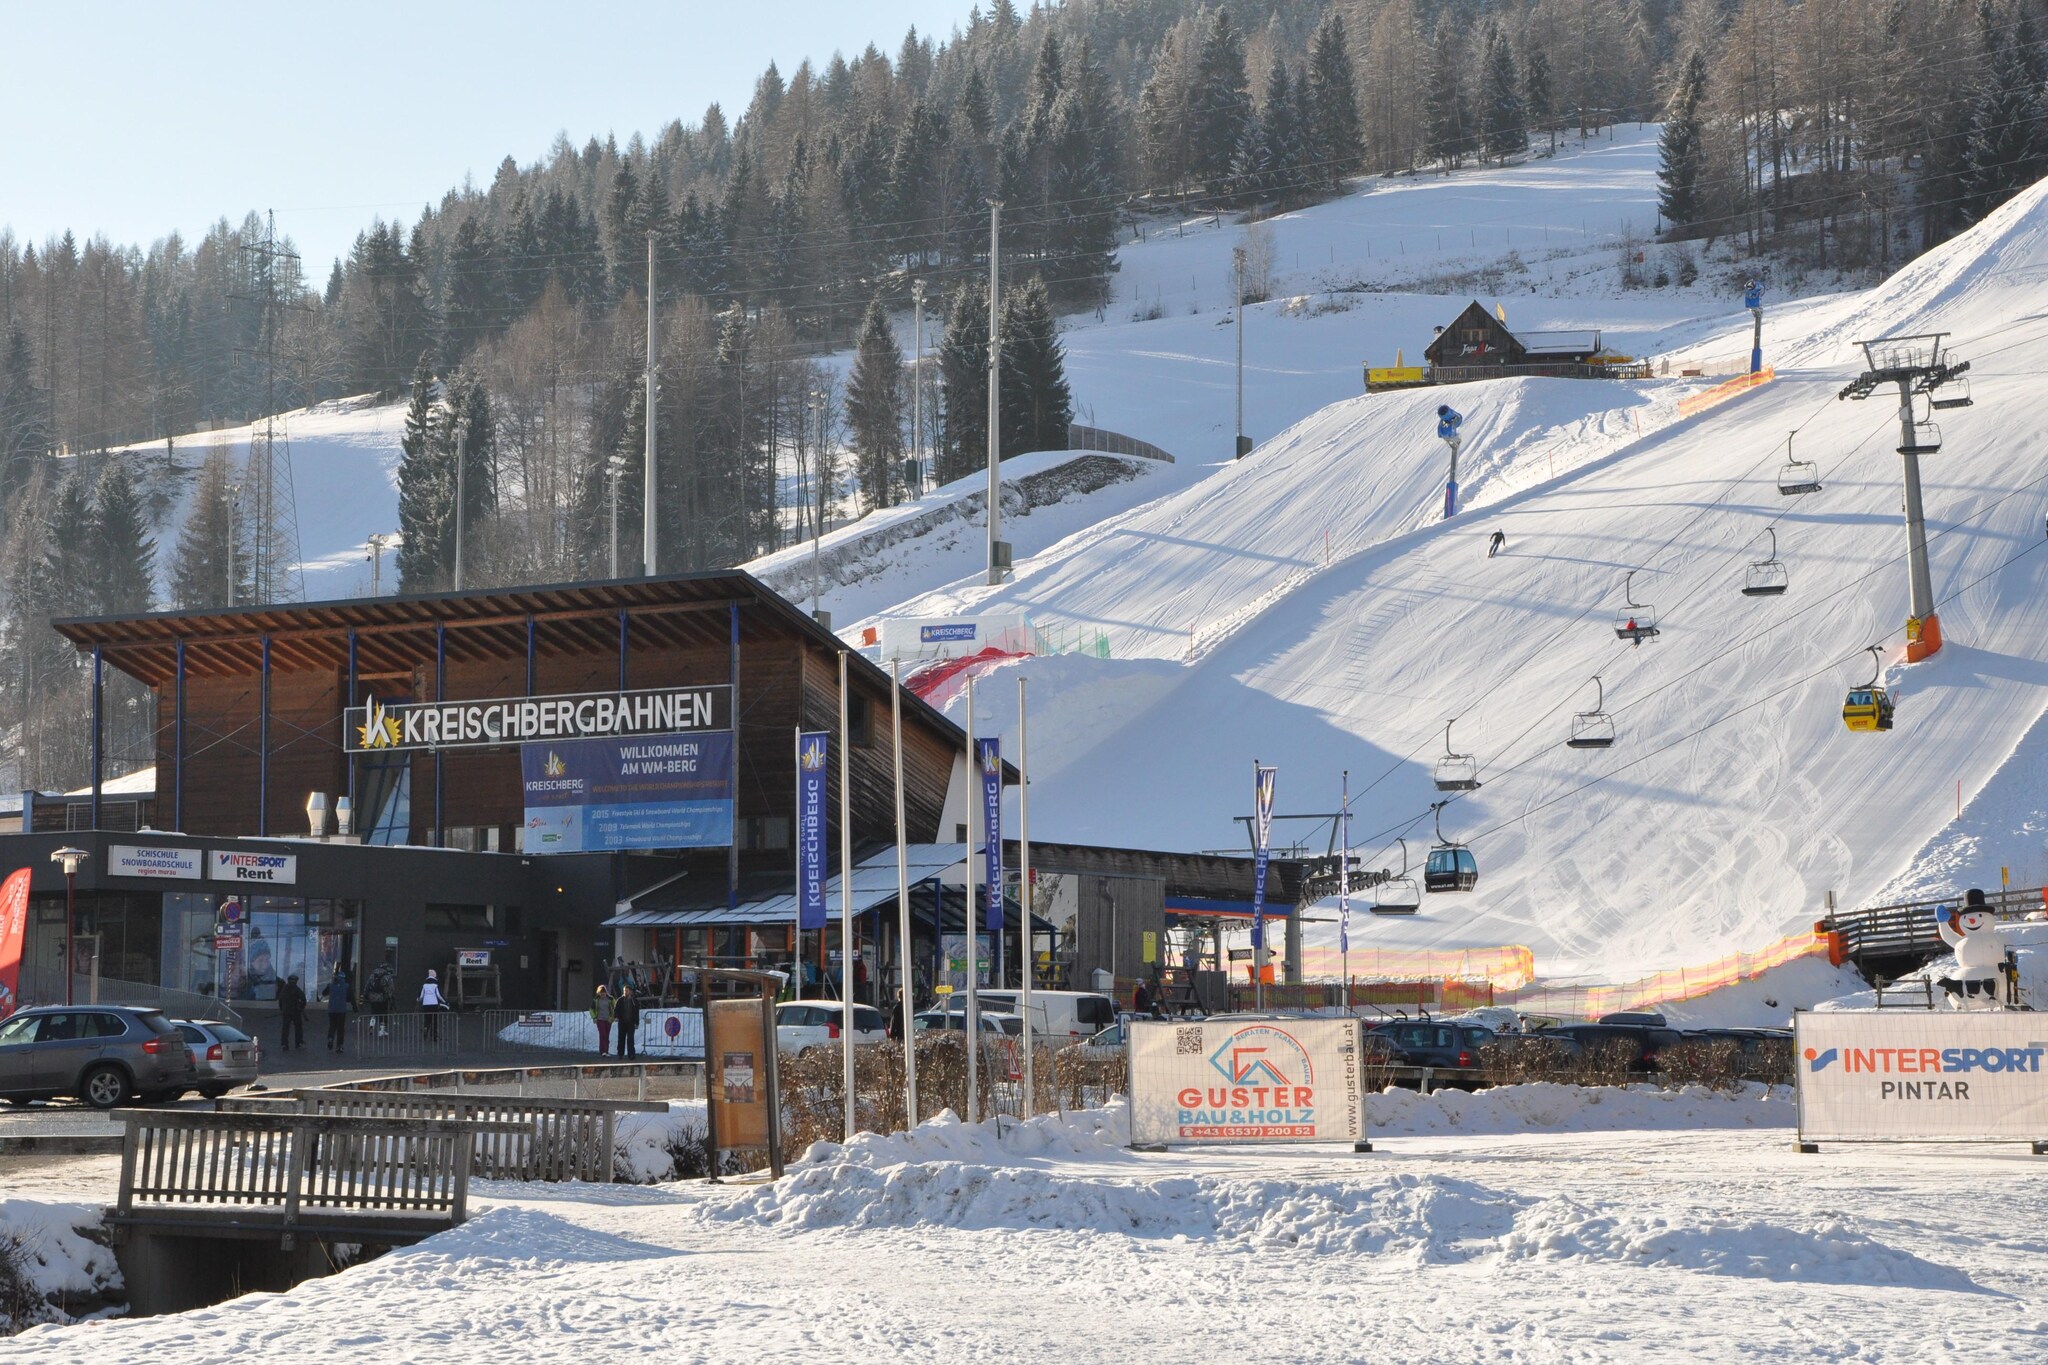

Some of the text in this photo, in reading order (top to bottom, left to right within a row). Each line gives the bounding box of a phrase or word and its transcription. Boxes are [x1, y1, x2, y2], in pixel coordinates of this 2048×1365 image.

[932, 628, 973, 636] KREISCHBERG
[404, 691, 713, 743] KREISCHBERGBAHNEN
[620, 744, 699, 759] WILLKOMMEN
[621, 760, 697, 775] AM WM-BERG
[526, 779, 583, 791] KREISCHBERG
[592, 810, 609, 819] 2015
[137, 850, 178, 859] SCHISCHULE
[230, 854, 287, 867] INTERSPORT
[121, 858, 193, 869] SNOWBOARDSCHULE
[138, 868, 157, 876] region
[236, 867, 274, 880] Rent
[1274, 1032, 1300, 1053] PLANEN
[1301, 1058, 1310, 1085] BAUEN
[1844, 1048, 2044, 1073] INTERSPORT
[1342, 1023, 1358, 1136] www.gusterbau.at
[1177, 1087, 1313, 1108] GUSTER
[1881, 1081, 1970, 1100] PINTAR
[1178, 1109, 1314, 1124] BAU&HOLZ
[1196, 1127, 1310, 1136] +43 (3537) 200 52
